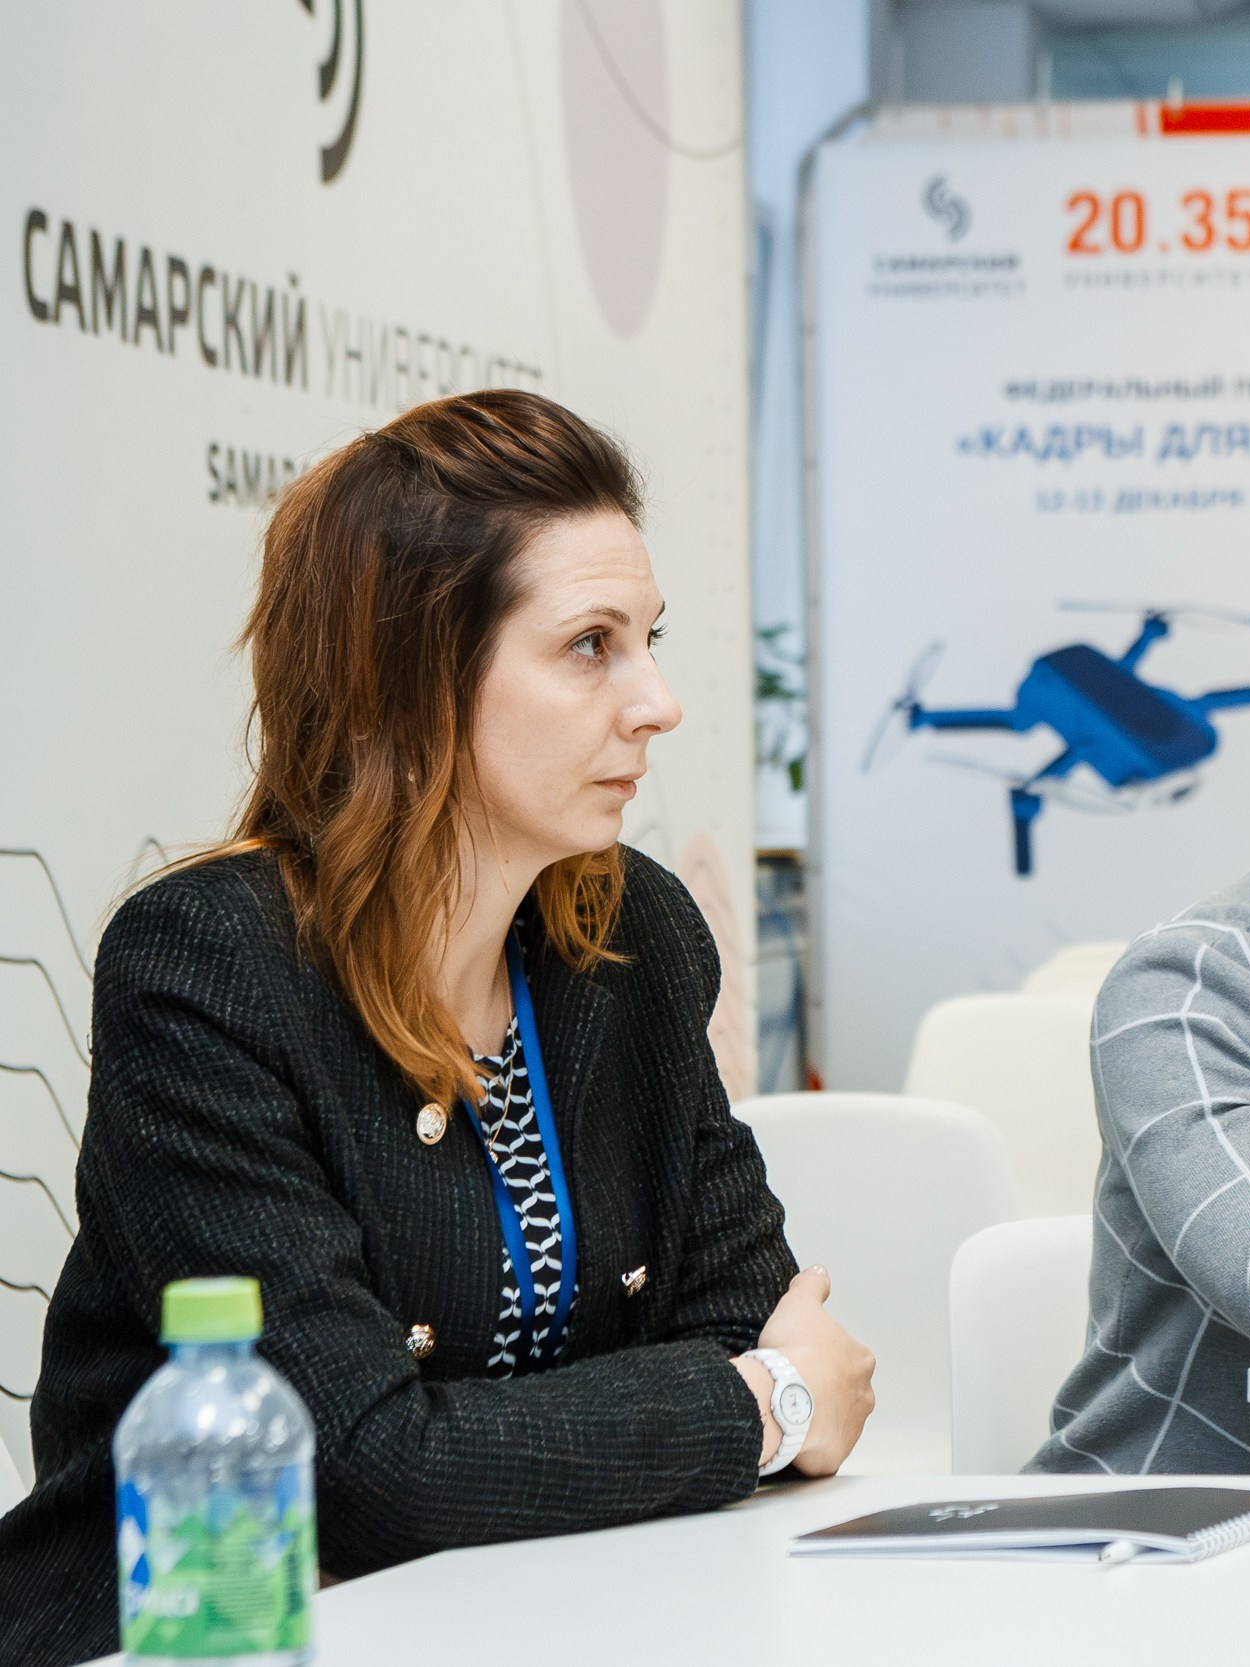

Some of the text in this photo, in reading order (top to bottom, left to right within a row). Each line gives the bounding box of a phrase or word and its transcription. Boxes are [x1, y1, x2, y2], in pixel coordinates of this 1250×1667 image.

[23, 206, 310, 391] САМАРСКИЙ
[1003, 374, 1224, 402] ФЕДЕРАЛЬНЫЙ
[956, 422, 1145, 462] «КАДРЫ
[207, 441, 305, 510] SAMAR
[1113, 489, 1245, 514] ДЕКАБРЯ
